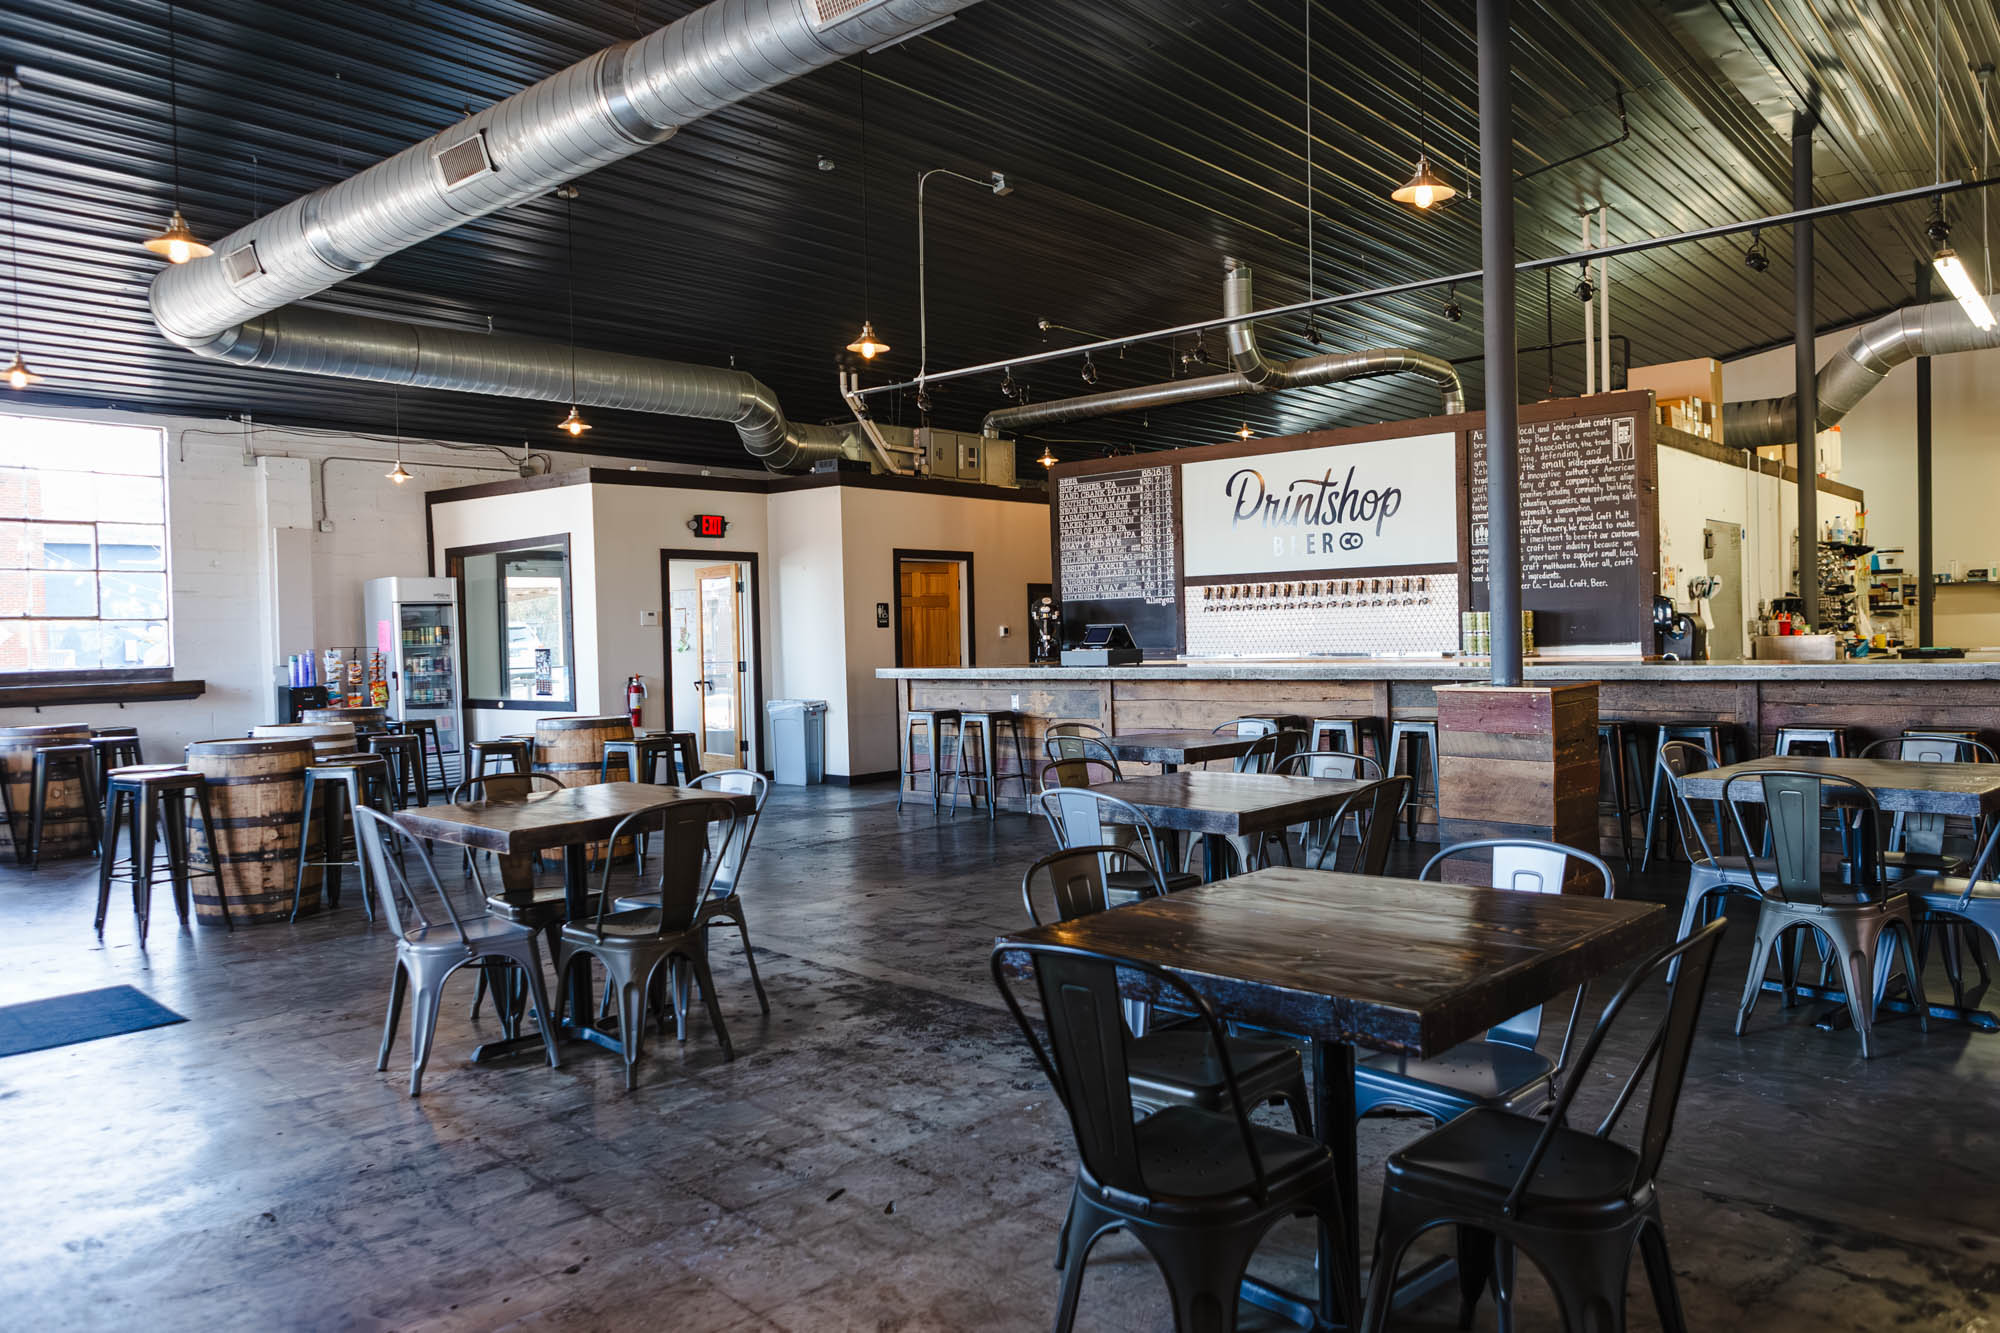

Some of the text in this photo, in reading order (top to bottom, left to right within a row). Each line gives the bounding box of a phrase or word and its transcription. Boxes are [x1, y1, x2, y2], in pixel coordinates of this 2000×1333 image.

[1537, 424, 1549, 433] and
[1553, 419, 1590, 430] independent
[1593, 417, 1611, 426] craft
[1534, 433, 1549, 442] Beer
[1534, 440, 1579, 452] Association,
[1585, 447, 1601, 455] and
[1527, 470, 1560, 479] innovative
[1565, 467, 1588, 476] culture
[1603, 462, 1635, 472] American
[1598, 474, 1616, 482] values
[1619, 472, 1634, 483] align
[1116, 494, 1130, 502] ALE
[1472, 493, 1487, 502] with
[1574, 484, 1603, 495] community
[1579, 495, 1590, 503] and
[1622, 490, 1636, 500] safe
[1226, 465, 1401, 537] Printshop
[1520, 507, 1552, 519] esponsible
[1554, 515, 1565, 523] also
[1576, 514, 1593, 524] proud
[1596, 511, 1611, 520] Craft
[1615, 510, 1629, 519] Malt
[702, 515, 722, 536] EXIT
[1578, 521, 1602, 530] decided
[1616, 519, 1635, 528] make
[1573, 530, 1597, 540] benefit
[1526, 544, 1544, 552] craft
[1547, 542, 1561, 550] beer
[1565, 540, 1590, 551] industry
[1593, 540, 1618, 548] because
[1528, 552, 1558, 563] important
[1573, 550, 1598, 562] support
[1472, 565, 1483, 573] and
[1522, 562, 1539, 571] craft
[1579, 559, 1599, 567] After
[1614, 557, 1633, 566] craft
[1098, 583, 1119, 591] AWAY
[1569, 578, 1589, 587] Craft.
[1590, 577, 1608, 587] Beer.
[1145, 596, 1174, 606] allergen
